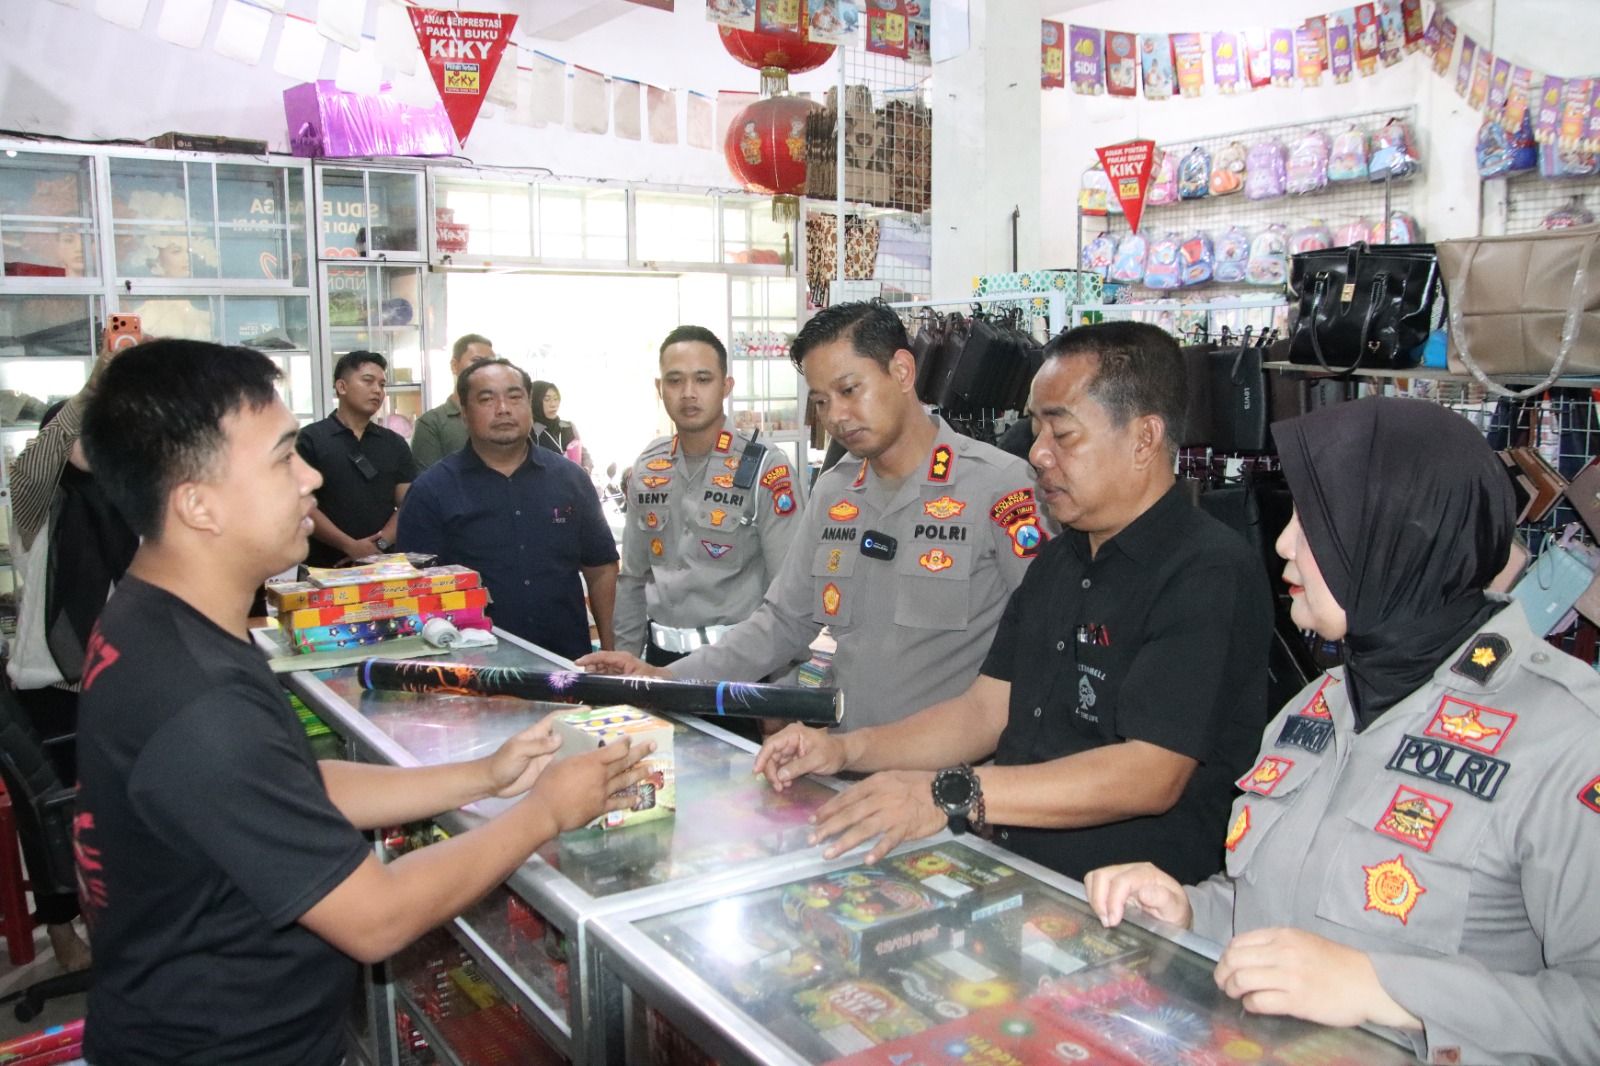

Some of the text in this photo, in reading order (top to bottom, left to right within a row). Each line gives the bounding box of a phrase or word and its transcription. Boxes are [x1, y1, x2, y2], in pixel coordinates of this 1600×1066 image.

[423, 14, 445, 25] ANAK
[426, 27, 499, 40] PAKAI BUKU
[430, 38, 493, 60] KIKY
[1124, 145, 1148, 155] PINTAR
[1107, 153, 1147, 165] PAKAI BUKU
[1110, 160, 1144, 177] KIKY
[638, 493, 669, 504] BENY
[704, 491, 744, 506] POLRI
[821, 527, 857, 541] ANANG
[914, 524, 967, 541] POLRI
[1396, 740, 1500, 794] POLRI
